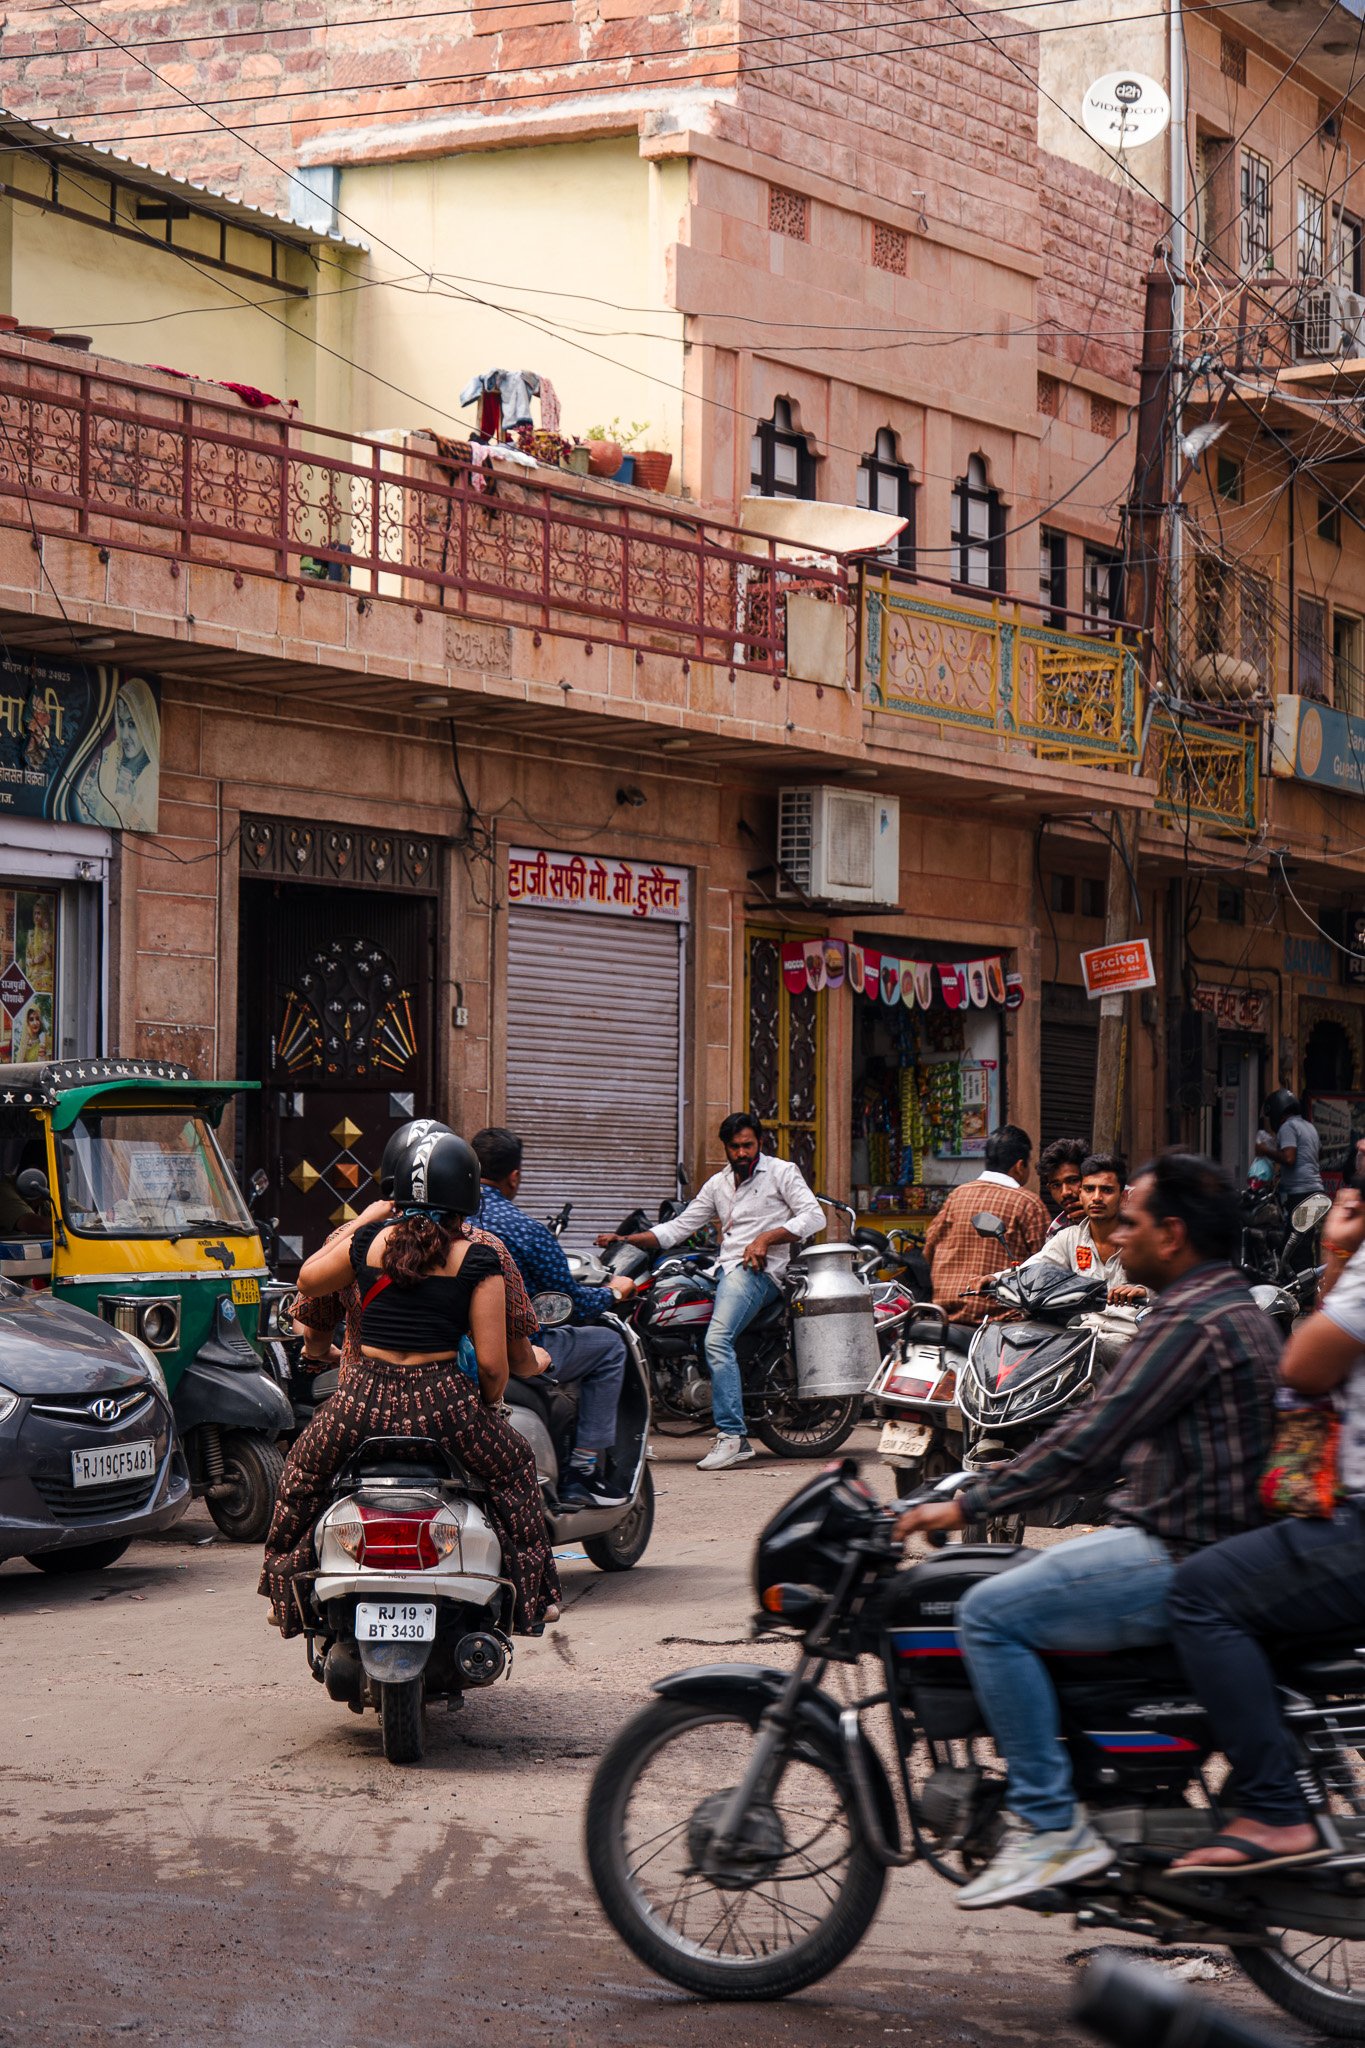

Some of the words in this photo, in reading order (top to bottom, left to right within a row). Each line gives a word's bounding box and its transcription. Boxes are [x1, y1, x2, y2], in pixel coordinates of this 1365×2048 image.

[1116, 84, 1141, 99] d2h
[1333, 755, 1357, 780] Guest
[509, 851, 548, 898] हाजी
[549, 856, 587, 901] सफी
[633, 867, 681, 916] हुसैन
[1092, 950, 1139, 972] Excitel
[656, 1300, 675, 1309] Hero
[83, 1449, 153, 1480] RJ19CF5481
[378, 1607, 396, 1620] RJ
[401, 1607, 417, 1620] 19
[369, 1624, 388, 1638] BT
[391, 1624, 424, 1638] 3430
